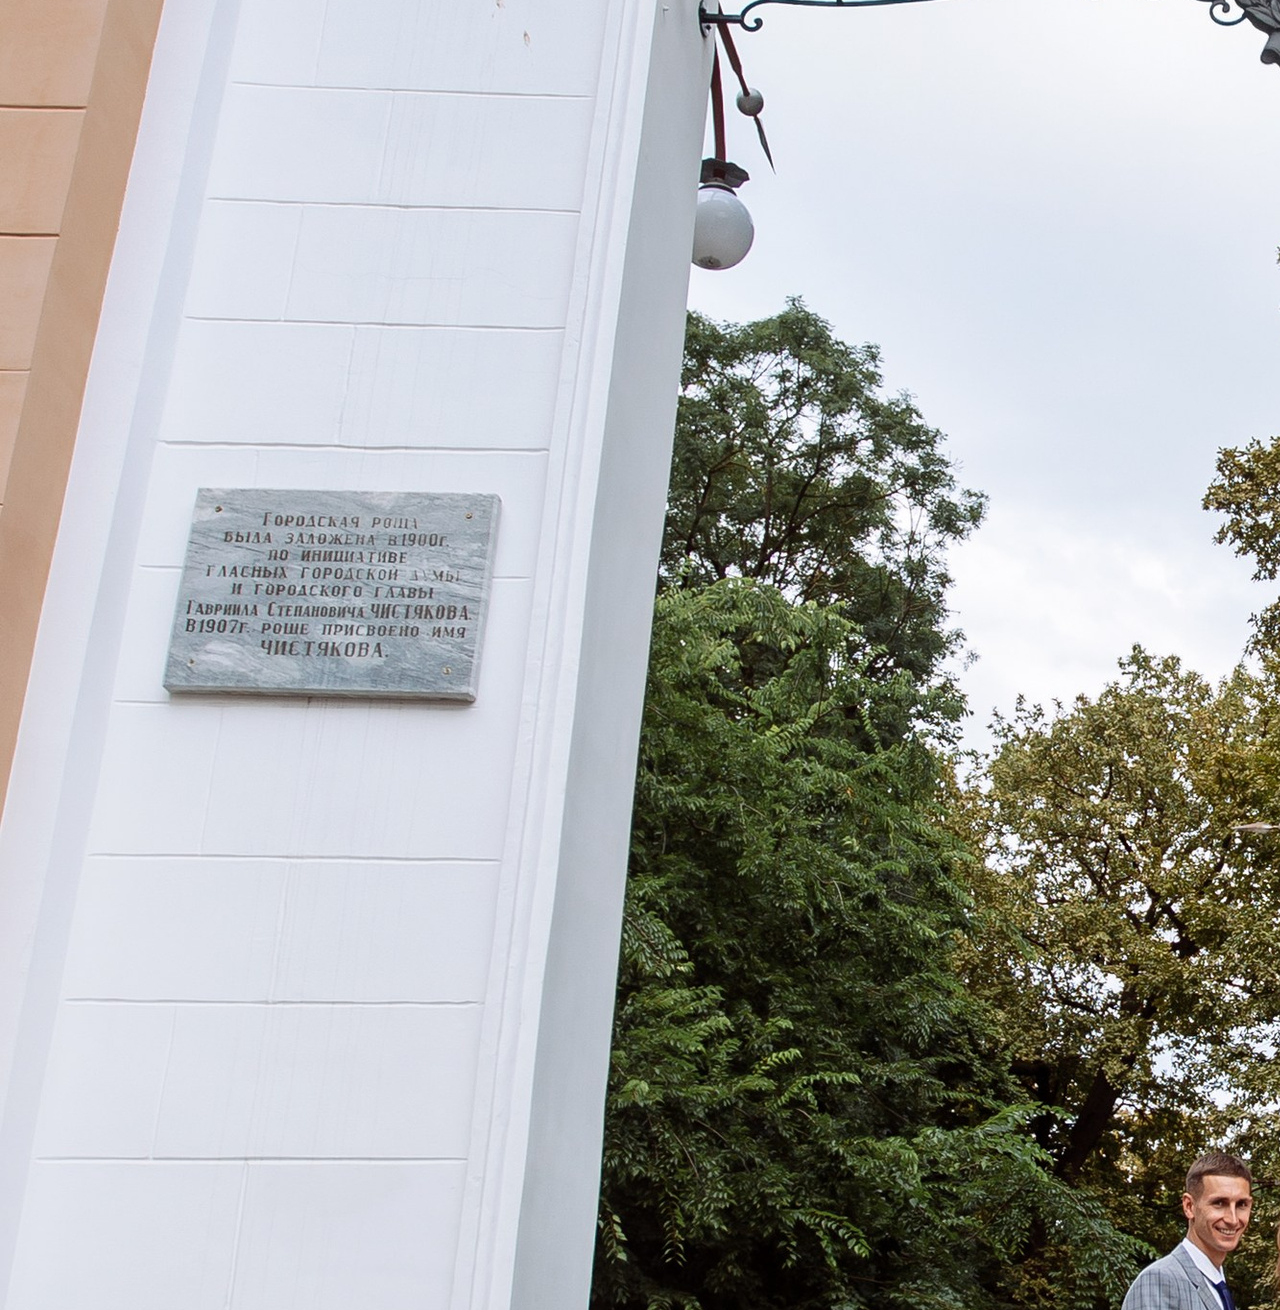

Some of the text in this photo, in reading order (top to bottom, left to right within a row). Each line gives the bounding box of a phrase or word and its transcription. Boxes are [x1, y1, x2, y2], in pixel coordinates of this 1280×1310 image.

[223, 531, 272, 544] БЫЛА
[285, 532, 375, 546] ЗАЛОЖЕНА
[267, 549, 408, 564] ПО ИНИЦИАТИВЕ
[206, 565, 287, 579] ГЛАСНЫХ
[231, 583, 434, 599] И ГОРОДСКОГО ГЛАВЫ
[321, 623, 420, 638] ПРИСВОЕНО
[431, 626, 466, 639] ИМЯ
[261, 640, 388, 658] ЧИСТЯКОВА.
